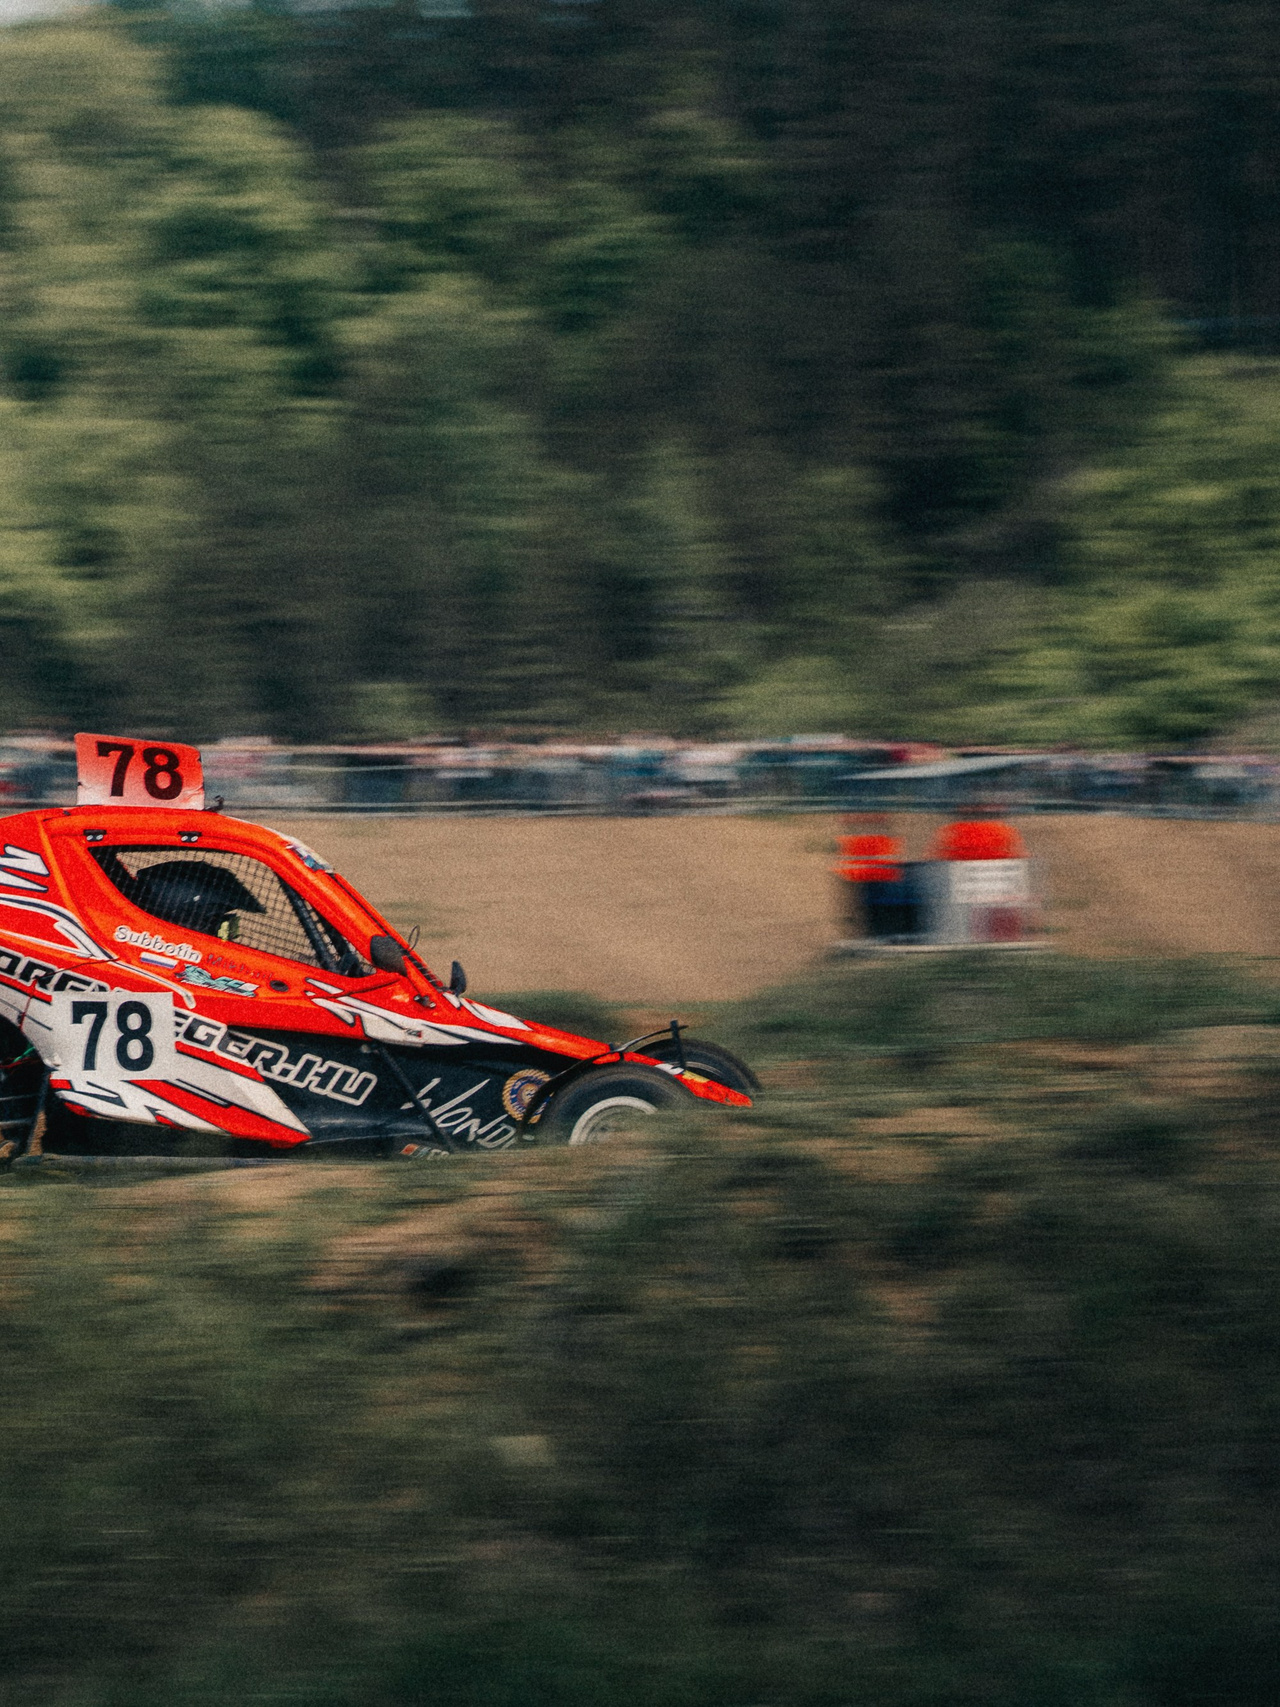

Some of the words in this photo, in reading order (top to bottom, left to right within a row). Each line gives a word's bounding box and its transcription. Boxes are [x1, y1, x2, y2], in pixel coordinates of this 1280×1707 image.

[96, 740, 184, 800] 78
[114, 926, 201, 963] Subbotin
[70, 1000, 154, 1072] 78
